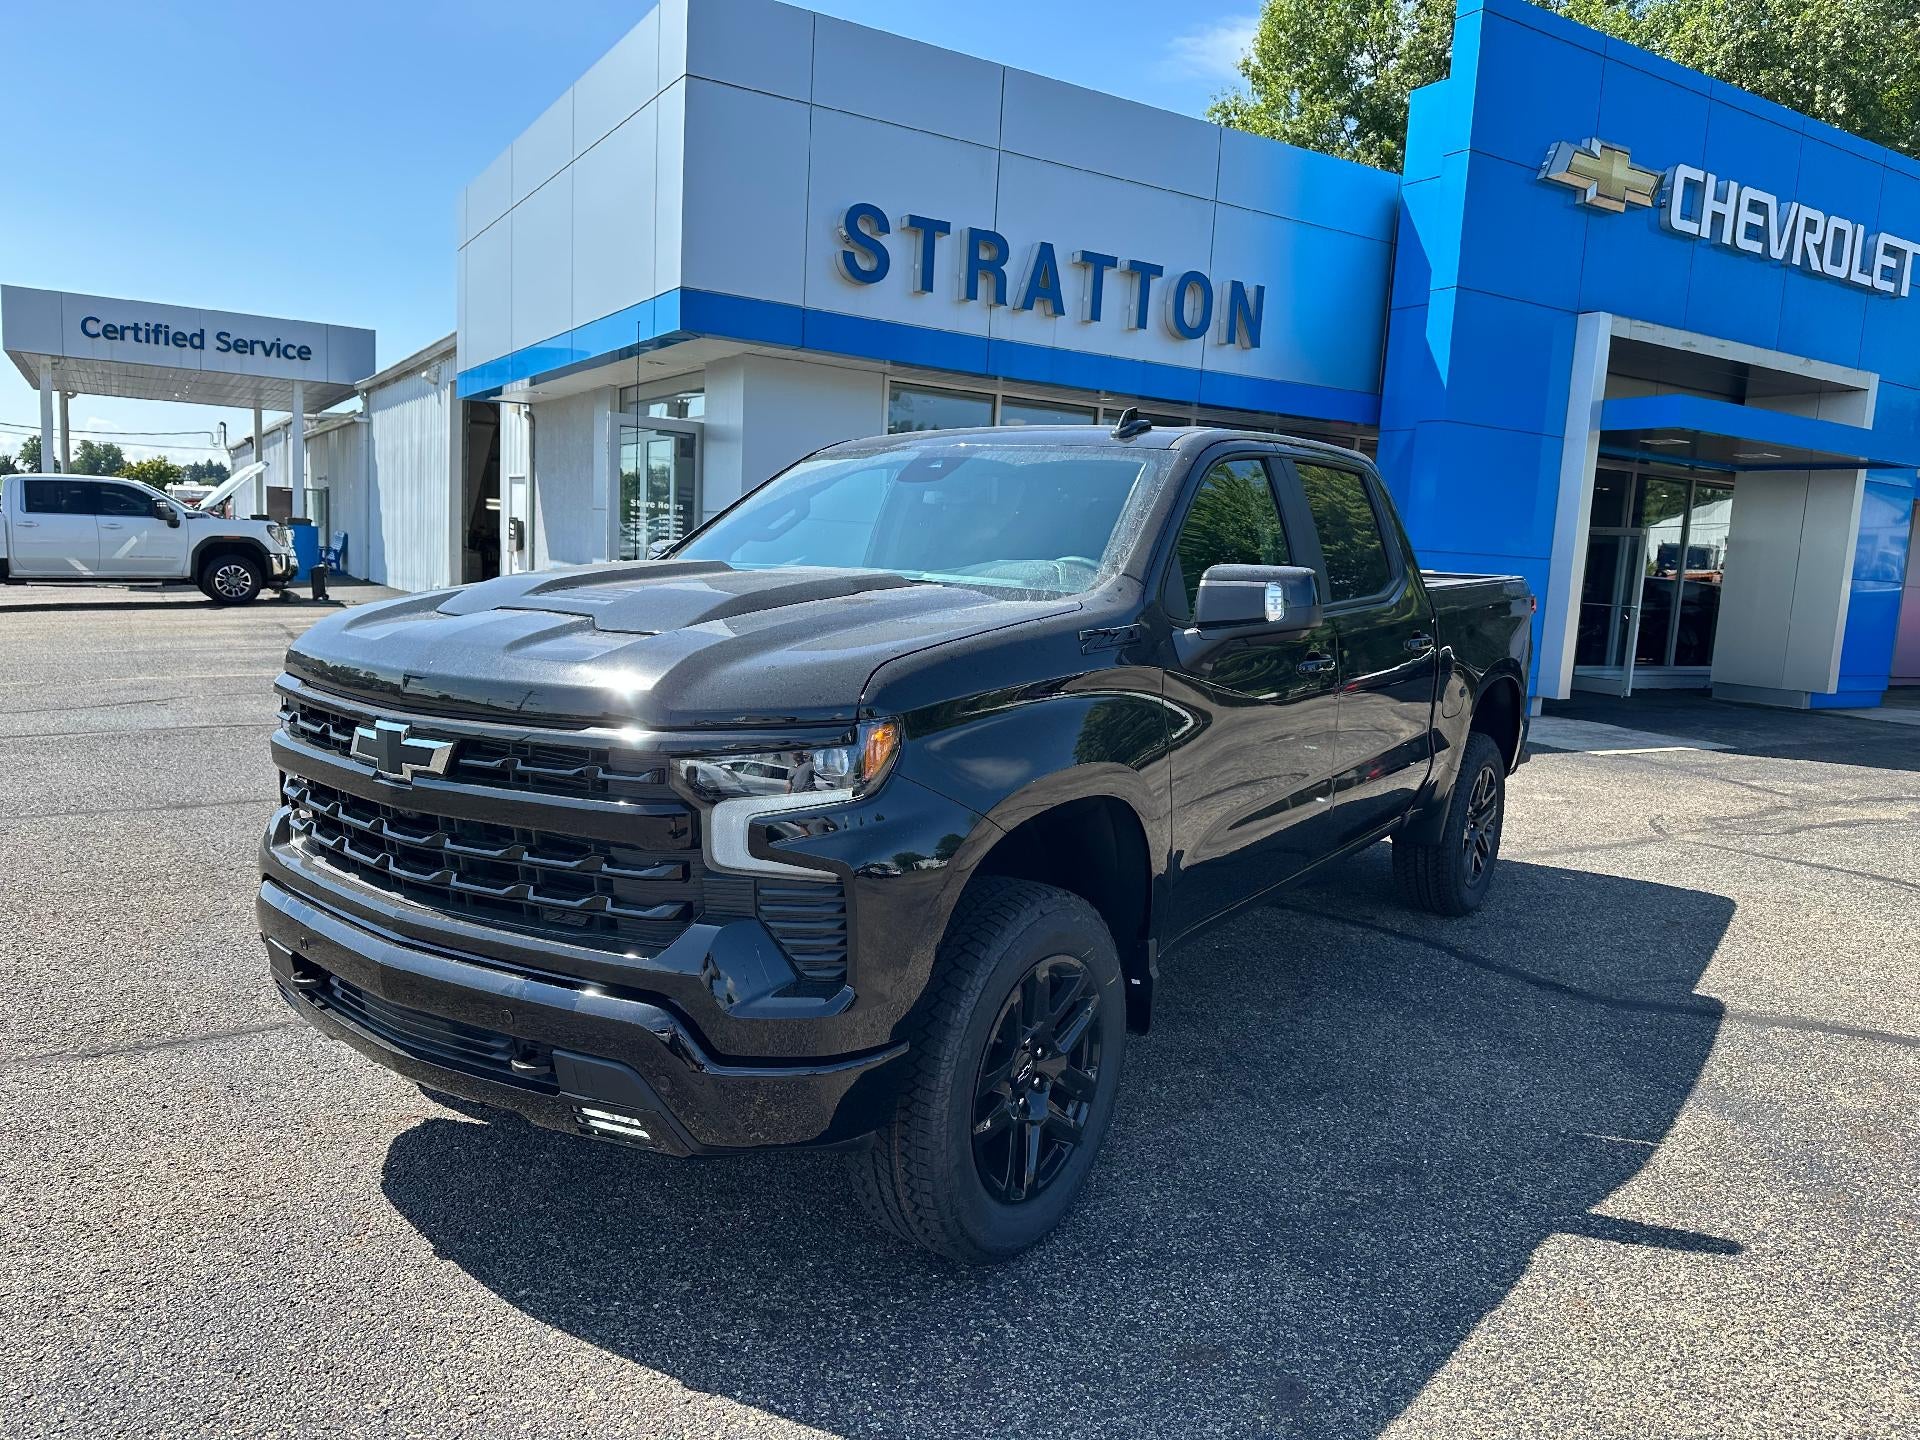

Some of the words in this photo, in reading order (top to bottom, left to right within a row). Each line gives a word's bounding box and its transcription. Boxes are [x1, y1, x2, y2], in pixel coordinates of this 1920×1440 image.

[1669, 163, 1920, 298] CHEVROLET
[836, 202, 1266, 350] STRATTON
[80, 316, 205, 350] Certified
[215, 331, 312, 361] Service
[630, 499, 656, 509] Store
